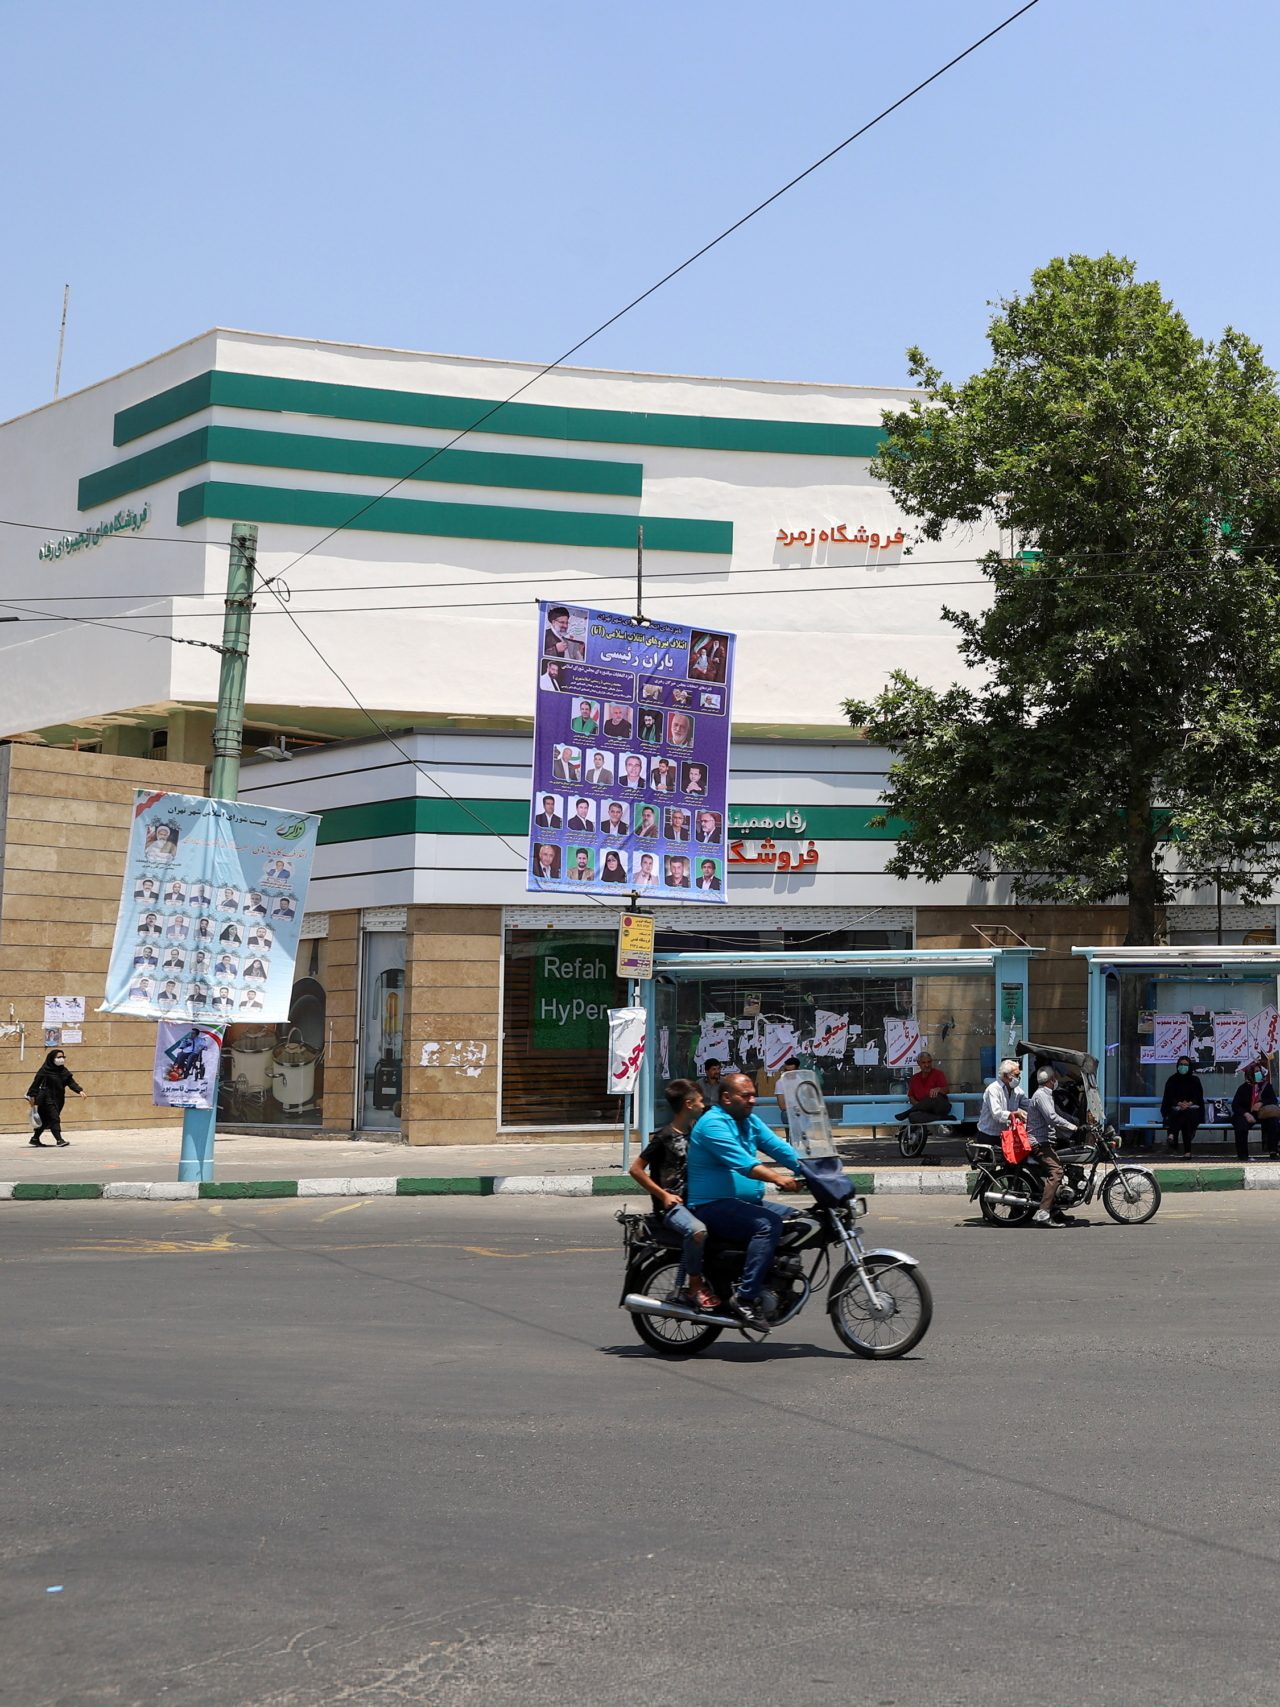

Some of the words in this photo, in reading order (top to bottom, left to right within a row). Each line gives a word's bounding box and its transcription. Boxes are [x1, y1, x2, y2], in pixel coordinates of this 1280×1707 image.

[776, 528, 815, 547] زمرد
[819, 524, 904, 549] فروشگاه
[38, 540, 56, 562] رفاه
[600, 646, 640, 668] رئیسی
[642, 651, 674, 671] یاران
[167, 804, 187, 815] تهران
[187, 807, 201, 815] شهر
[225, 813, 248, 824] شورای
[774, 808, 807, 834] رفاه
[727, 837, 819, 870] فروشگ
[544, 956, 607, 979] Refah
[541, 998, 608, 1026] Hyper
